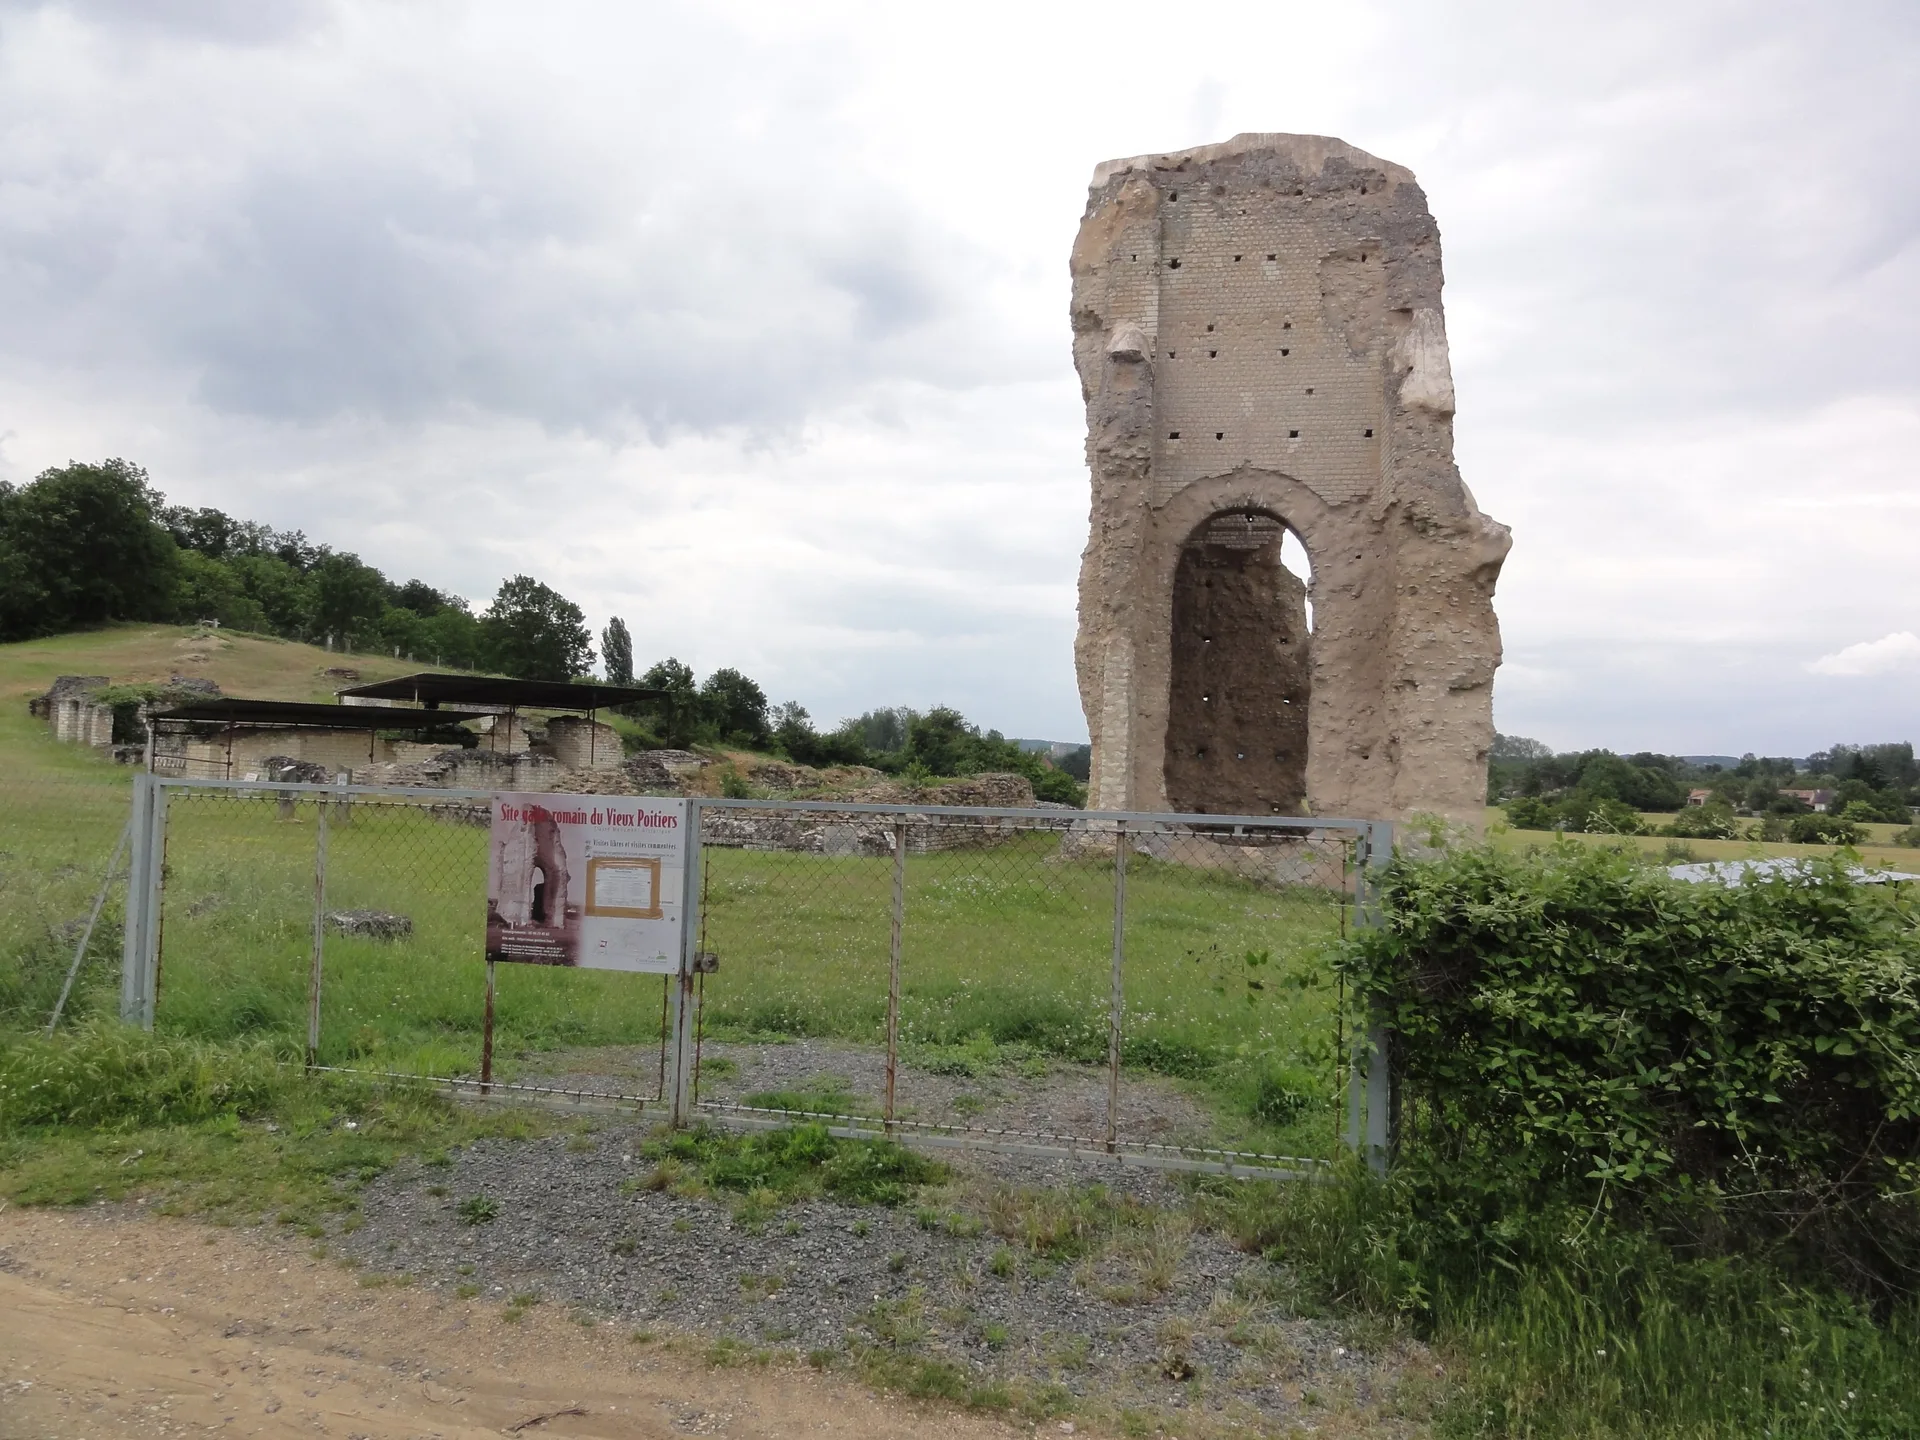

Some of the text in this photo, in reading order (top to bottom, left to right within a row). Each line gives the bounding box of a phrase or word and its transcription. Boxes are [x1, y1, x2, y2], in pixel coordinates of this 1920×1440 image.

[500, 803, 519, 822] Site
[552, 807, 587, 825] romain
[590, 808, 603, 825] du
[606, 808, 634, 827] Vieux
[637, 809, 678, 829] Poitiers
